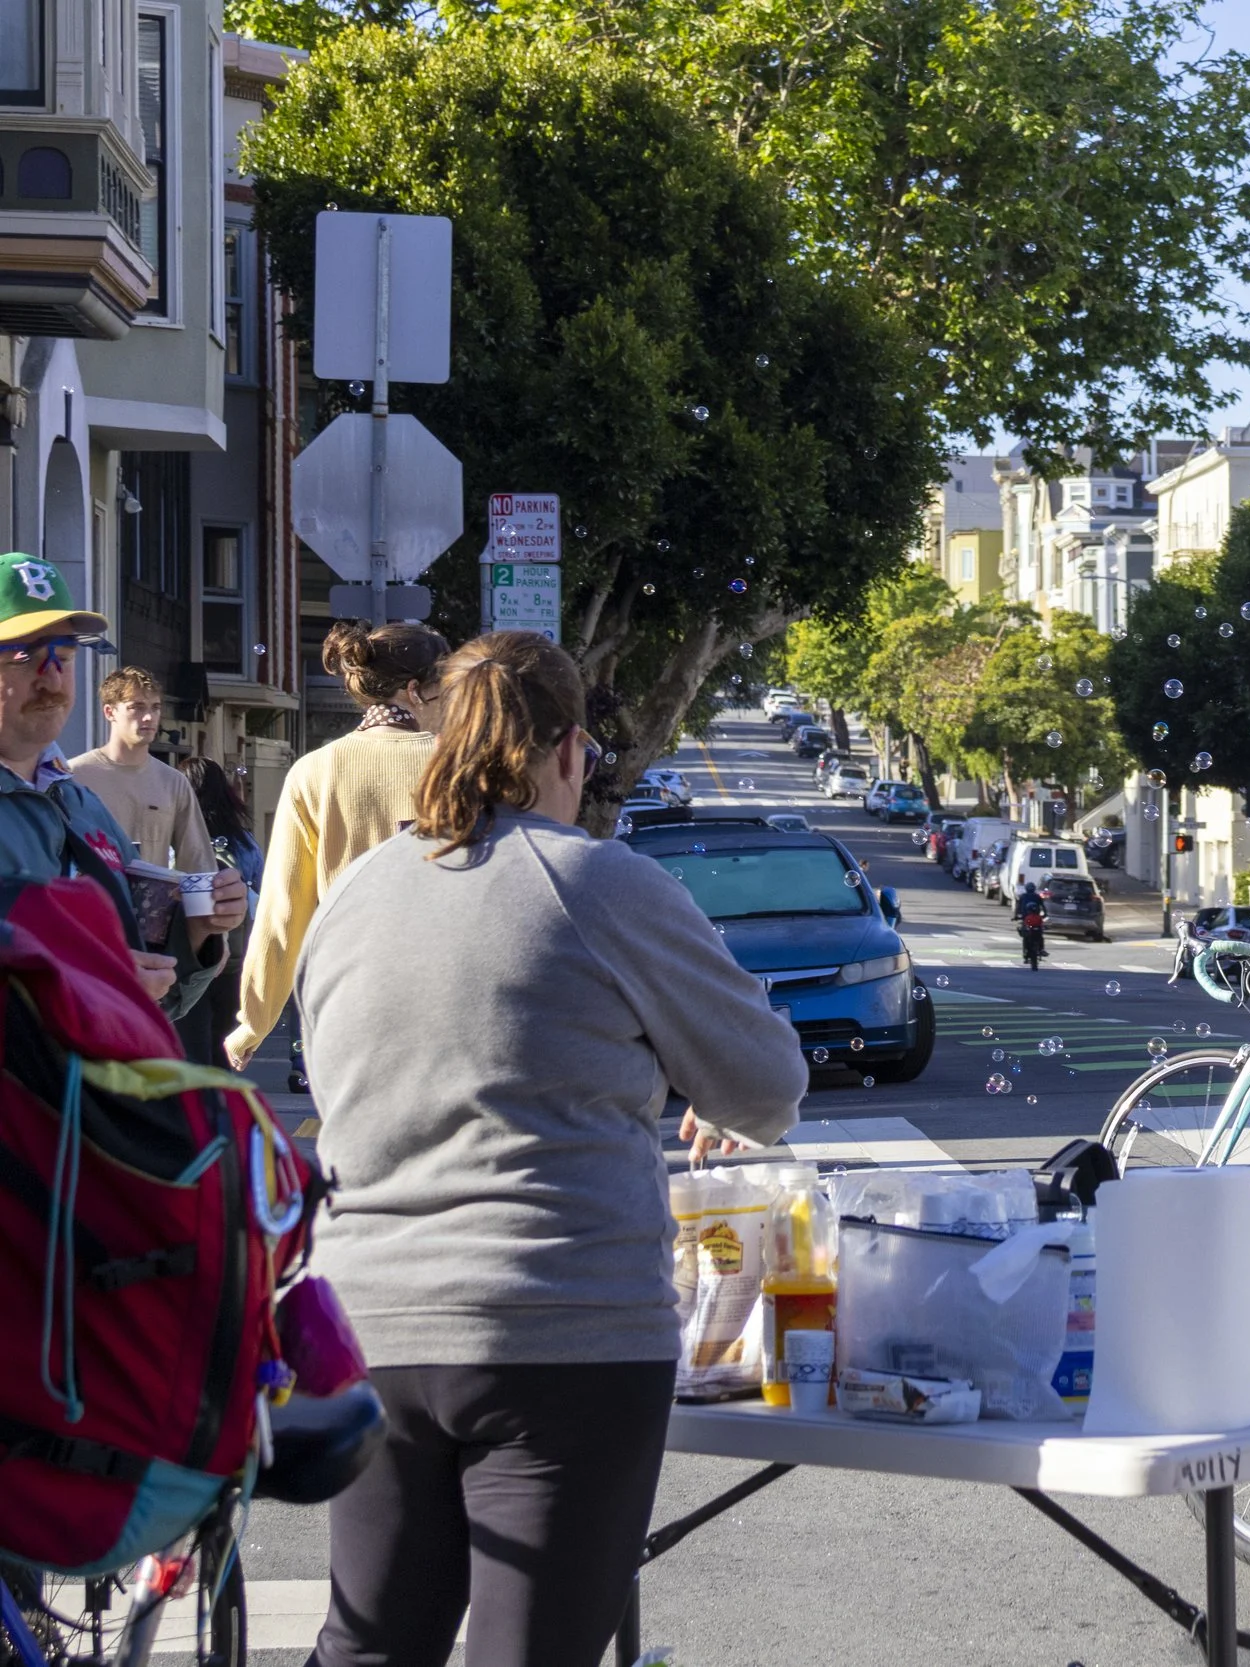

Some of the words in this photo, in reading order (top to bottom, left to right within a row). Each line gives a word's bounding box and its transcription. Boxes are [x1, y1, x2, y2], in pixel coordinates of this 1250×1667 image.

[493, 497, 512, 514] NO
[515, 501, 556, 514] PARKING
[496, 536, 555, 547] WEDNESDAY
[497, 567, 510, 585] 2
[523, 567, 550, 577] HOUR
[516, 578, 557, 589] PARKING
[500, 607, 518, 617] MON
[541, 608, 555, 617] FRI
